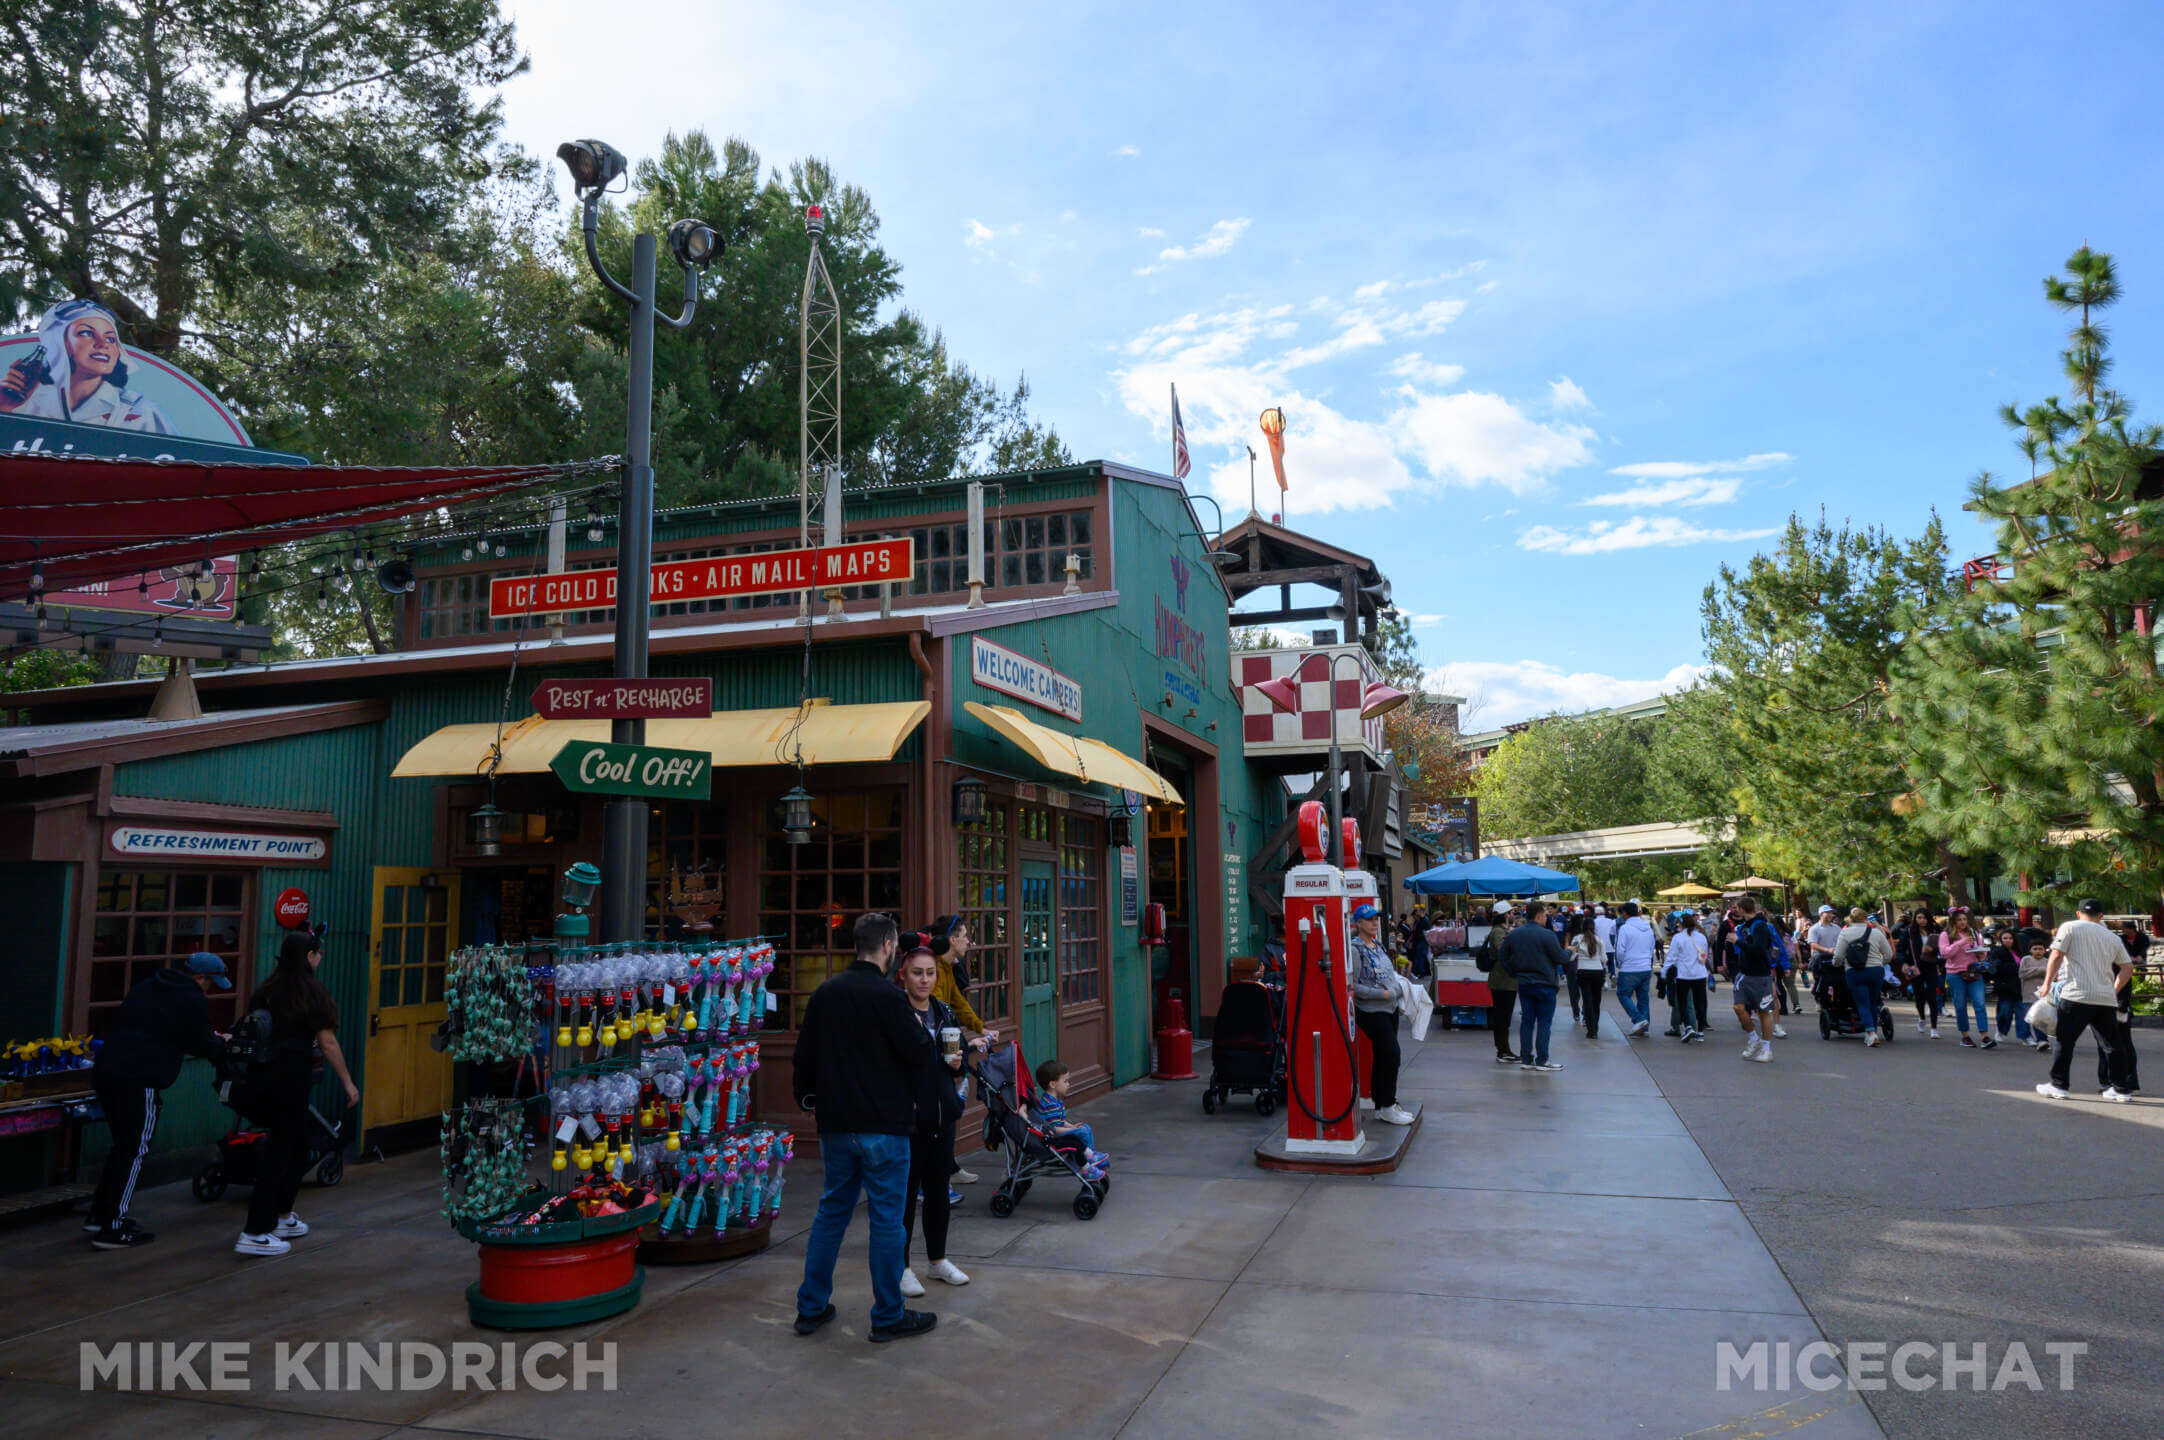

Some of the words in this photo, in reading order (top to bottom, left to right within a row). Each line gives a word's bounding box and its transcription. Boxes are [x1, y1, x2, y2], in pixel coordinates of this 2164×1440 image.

[508, 585, 537, 608] ICE
[546, 578, 597, 604] COLD
[706, 564, 742, 589] AIR
[752, 558, 806, 585] MAIL
[827, 549, 890, 578] MAPS
[977, 646, 1035, 693] WELCOME
[1038, 672, 1081, 713] CAMPERS!
[547, 687, 594, 712] REST
[614, 687, 705, 711] RECHARGE
[579, 747, 638, 785] Cool
[642, 756, 704, 787] Off!
[127, 833, 261, 852] REFRESHMENT
[266, 840, 314, 854] POINT
[1295, 880, 1328, 888] REGULAR
[280, 901, 309, 915] Coca-Cola
